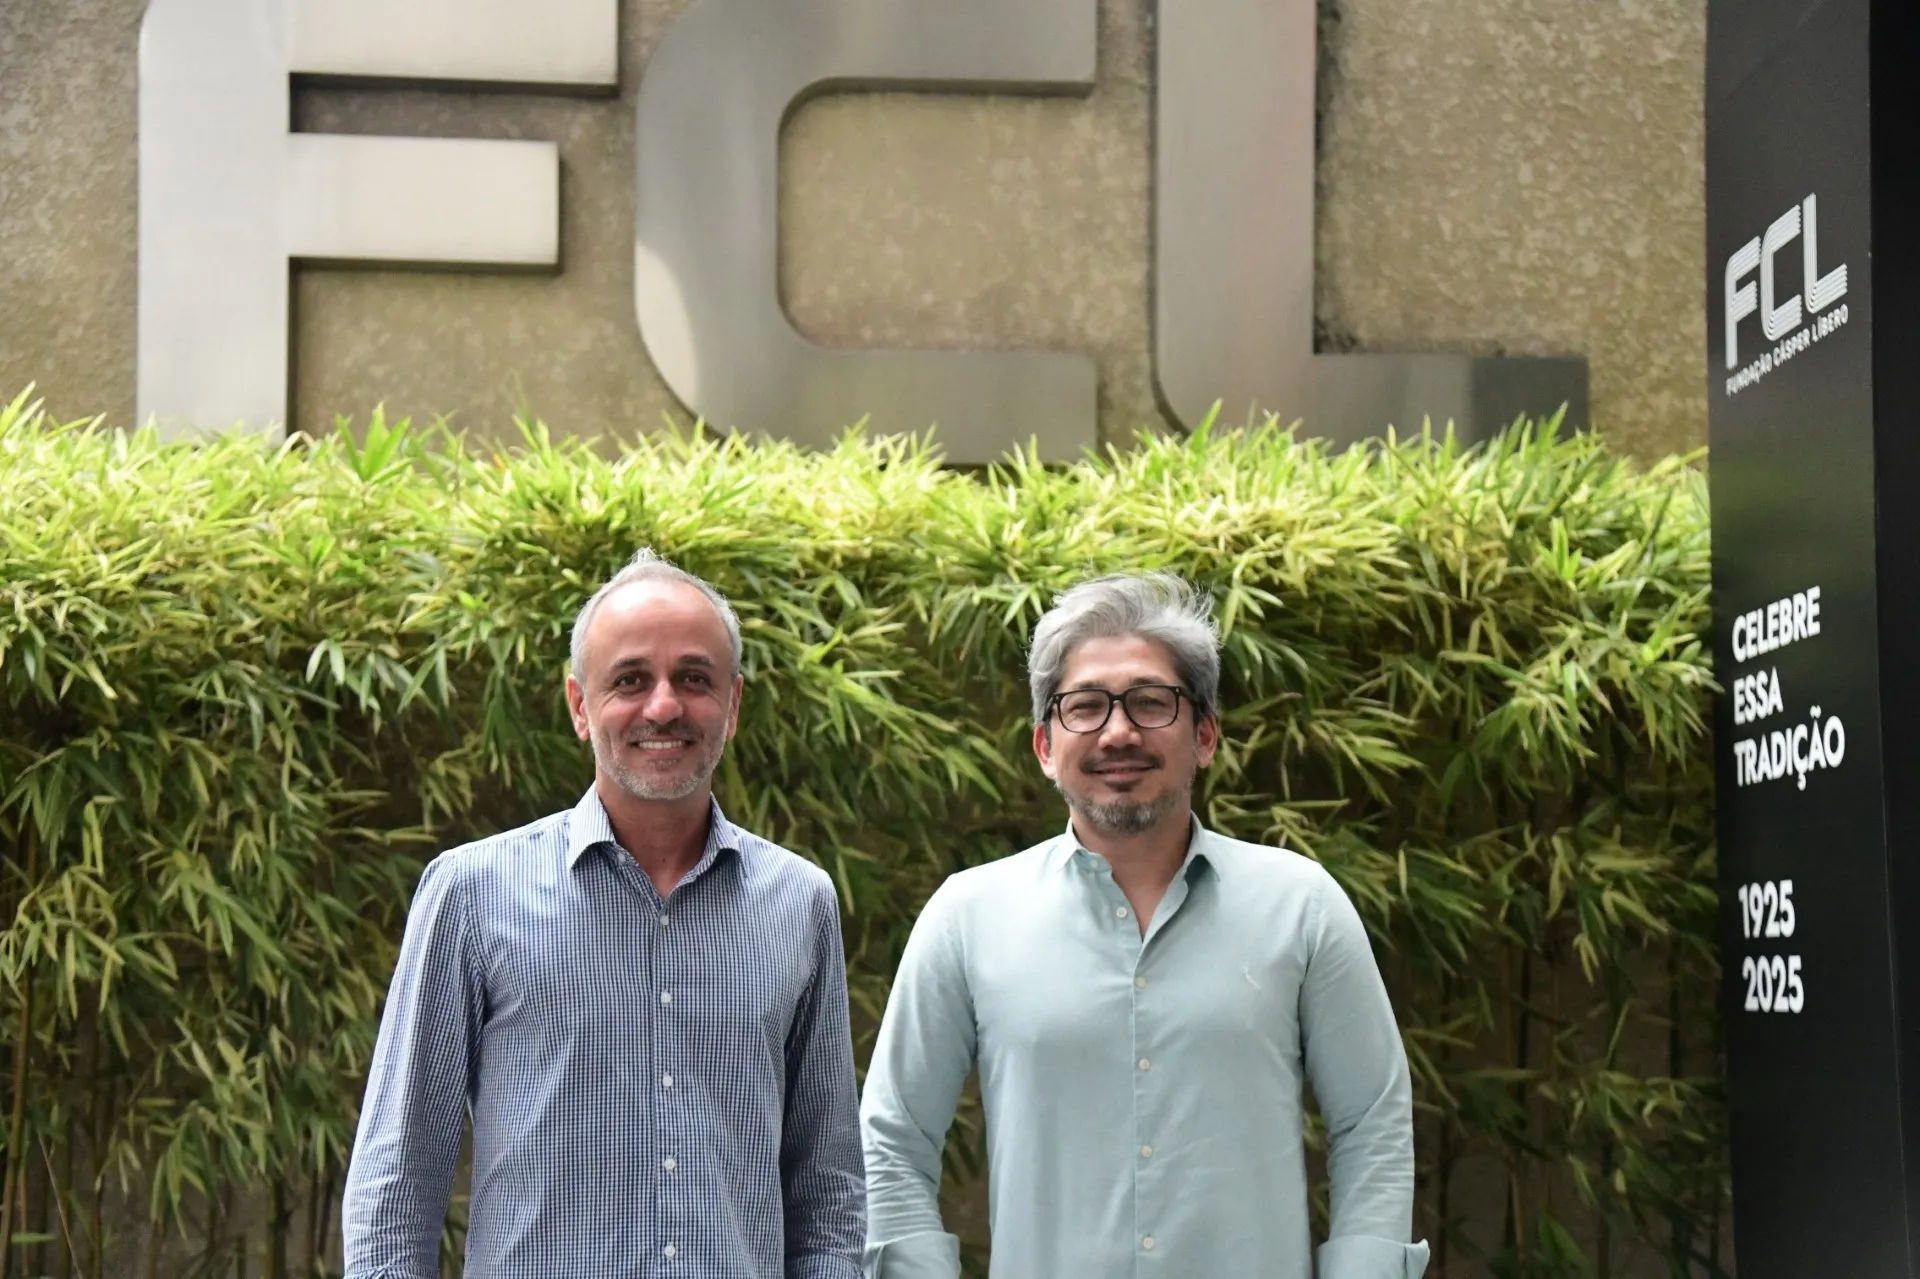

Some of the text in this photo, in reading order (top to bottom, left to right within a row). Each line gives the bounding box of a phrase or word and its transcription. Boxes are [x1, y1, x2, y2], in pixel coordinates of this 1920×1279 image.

[137, 0, 1590, 465] FCL
[1725, 192, 1847, 371] FCL
[1726, 303, 1848, 397] FUNDAÇÃO CÁSPER LÍBERO
[1732, 585, 1820, 663] CELEBRE
[1733, 665, 1784, 726] ESSA
[1733, 704, 1845, 791] TRADIÇÃO
[1738, 878, 1796, 939] 1925
[1742, 954, 1804, 1014] 2025
